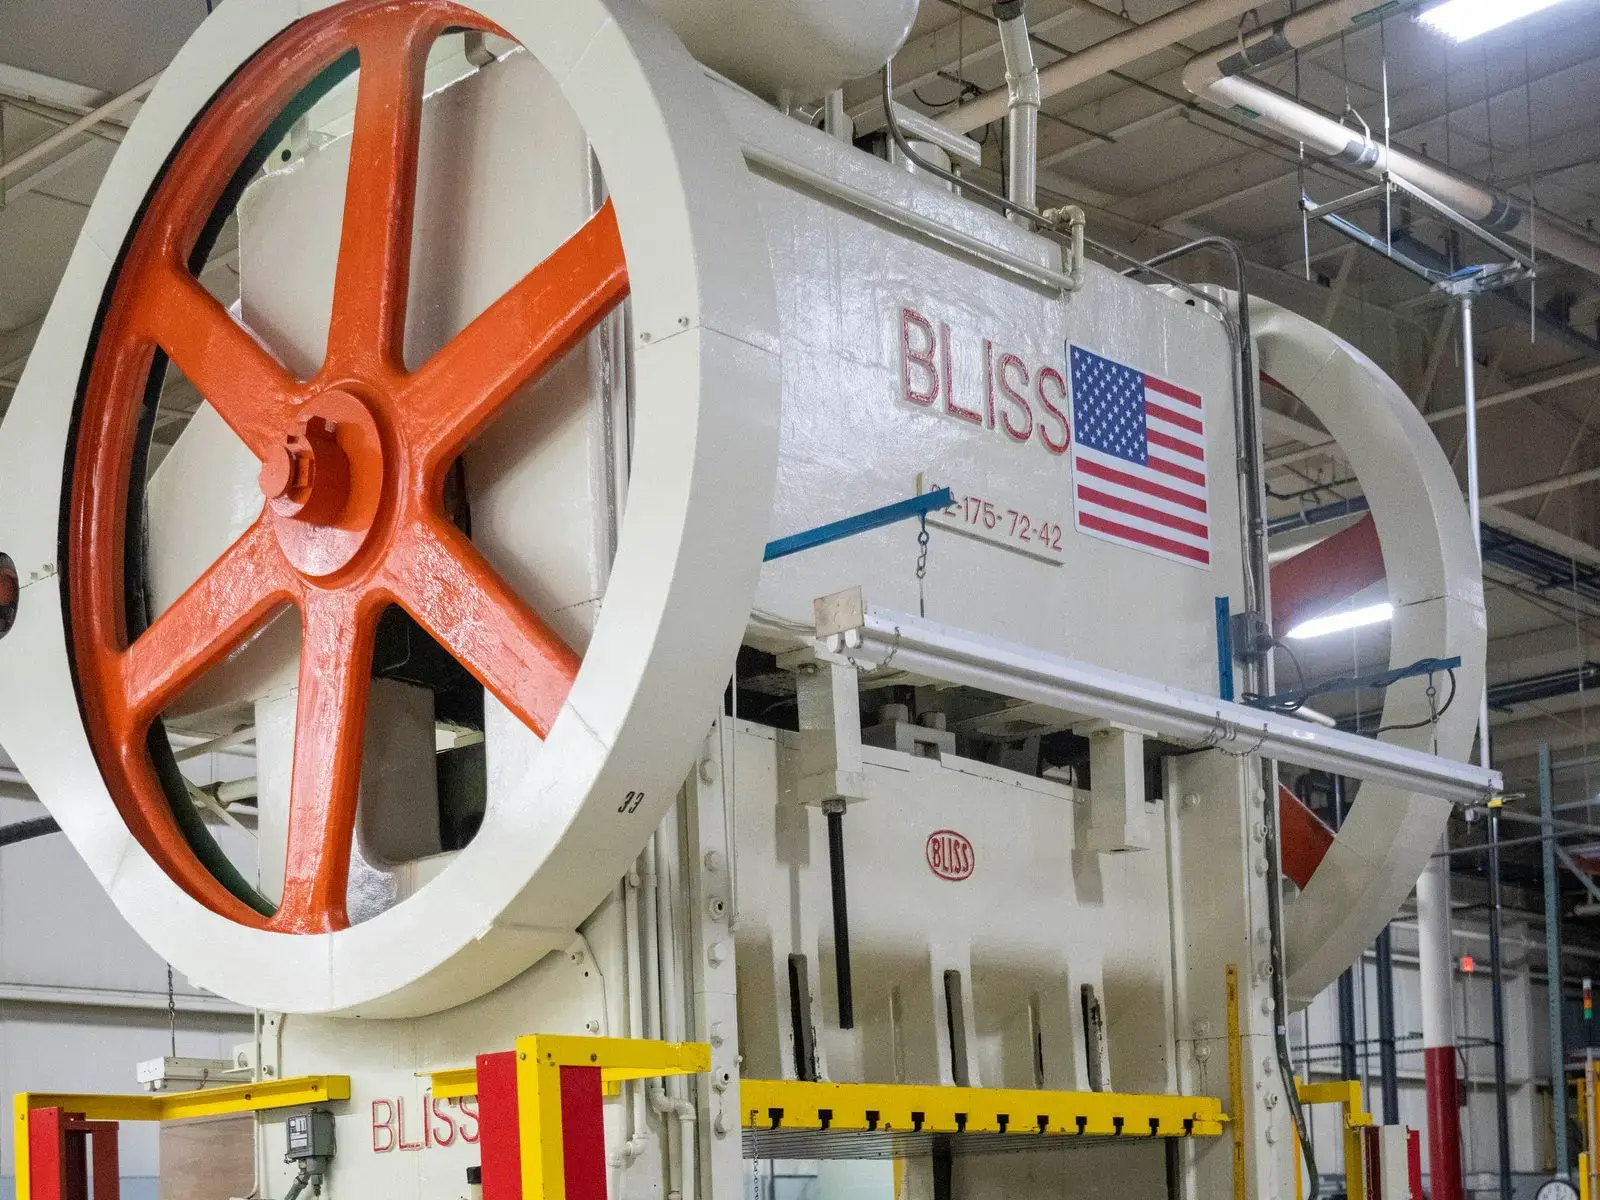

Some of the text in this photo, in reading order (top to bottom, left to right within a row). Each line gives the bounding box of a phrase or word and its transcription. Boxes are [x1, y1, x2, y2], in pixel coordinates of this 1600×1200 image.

[901, 308, 1071, 456] BLISS
[617, 791, 645, 814] 33
[931, 836, 969, 874] BLISS
